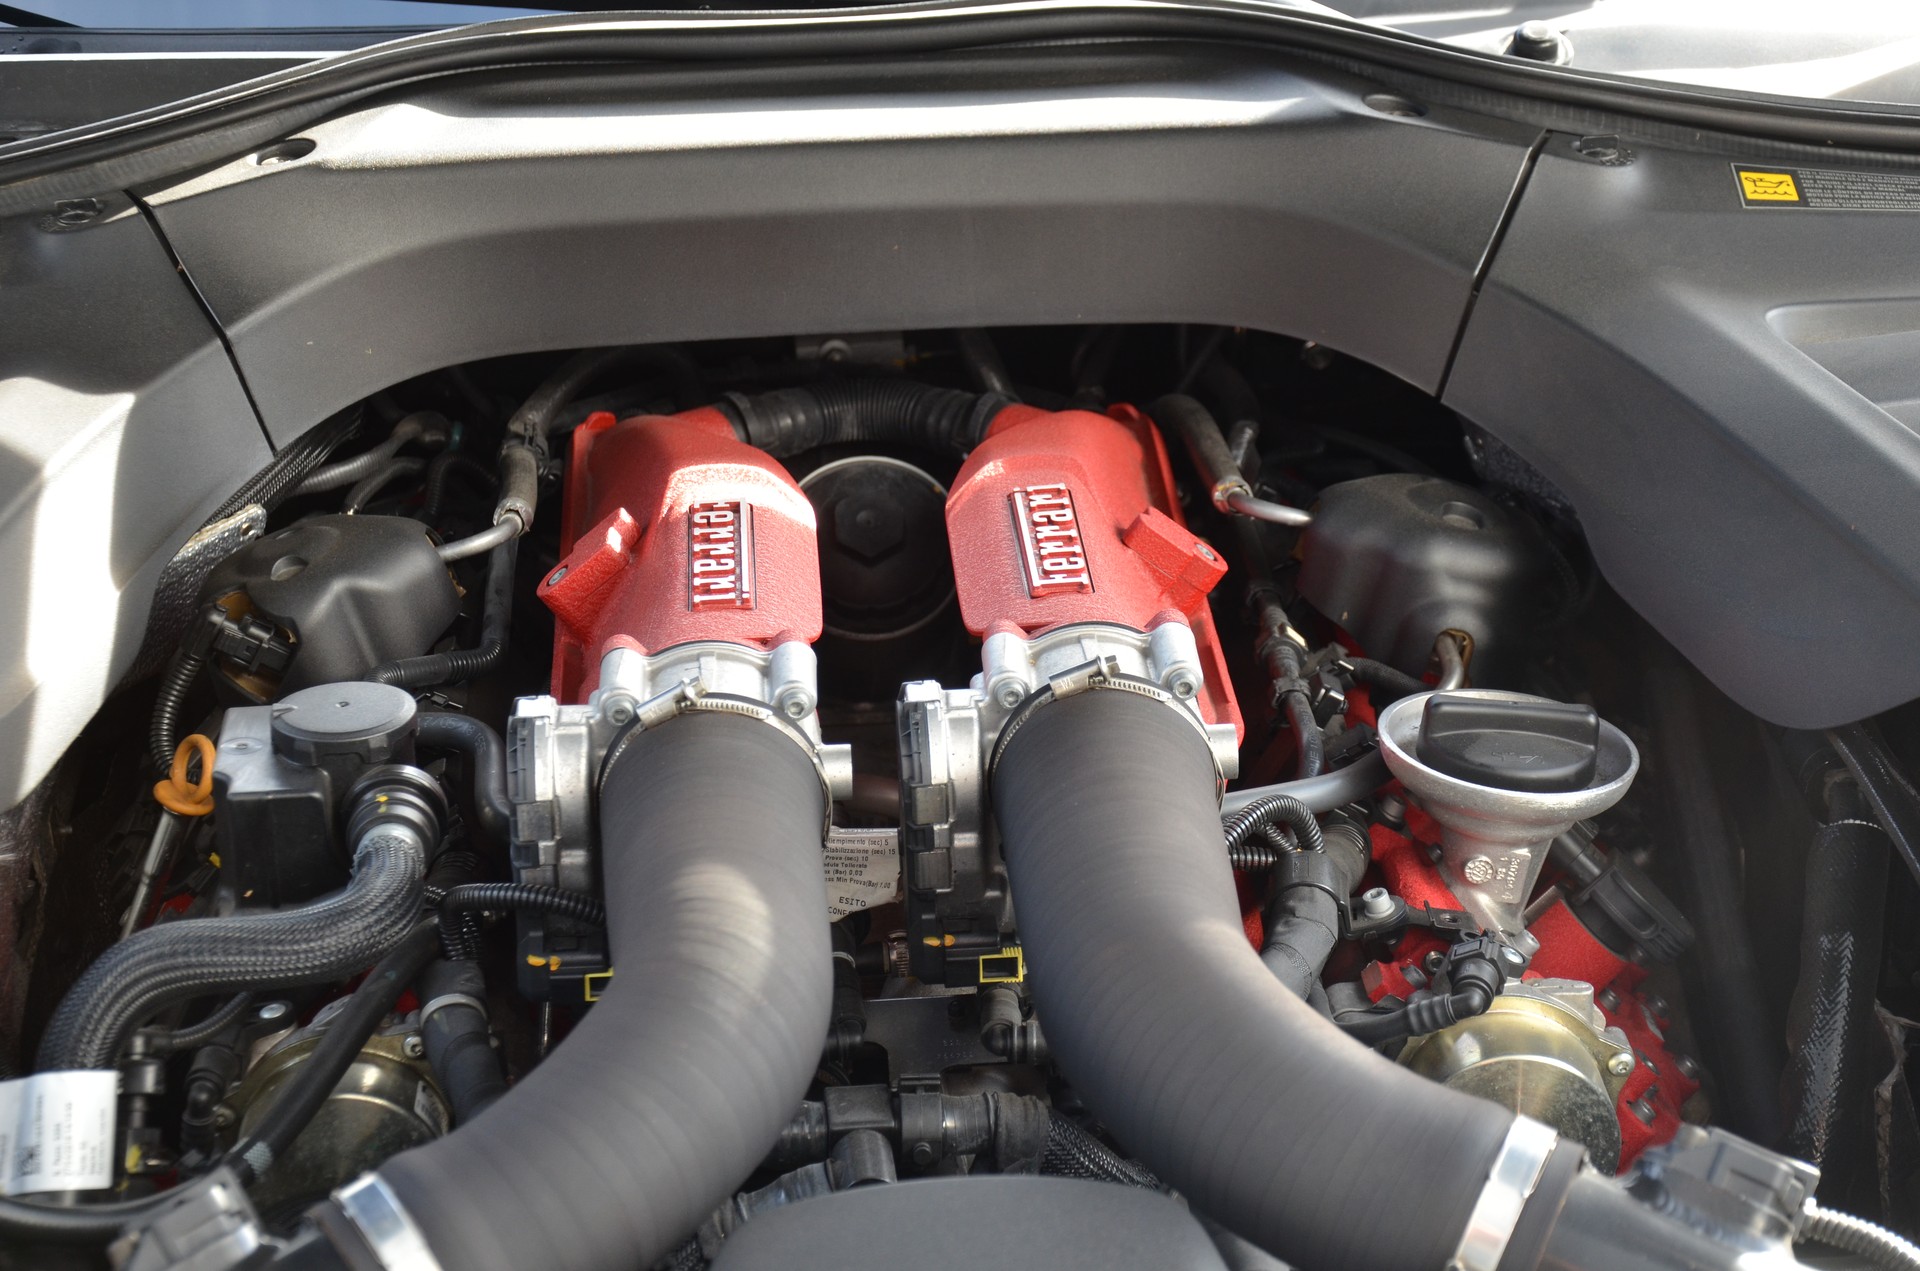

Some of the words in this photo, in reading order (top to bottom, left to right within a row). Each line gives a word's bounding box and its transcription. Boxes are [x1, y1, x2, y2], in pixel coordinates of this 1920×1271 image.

[694, 498, 750, 604] Ferrari
[1013, 482, 1089, 587] Ferrari
[839, 896, 866, 908] ESITO
